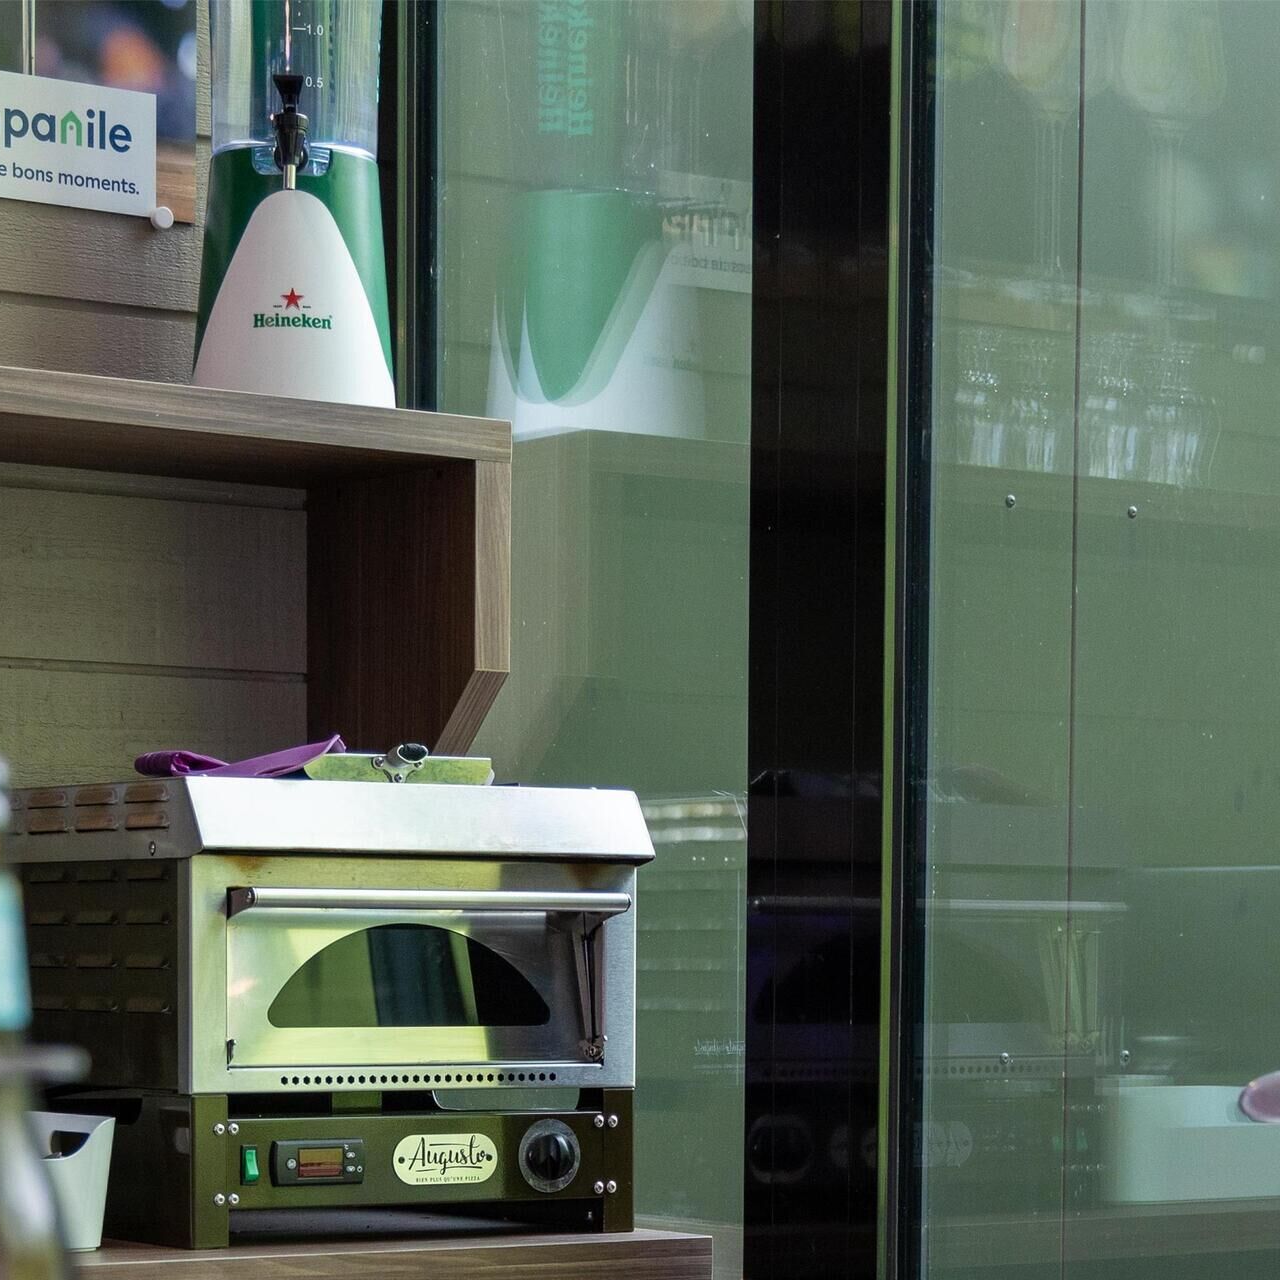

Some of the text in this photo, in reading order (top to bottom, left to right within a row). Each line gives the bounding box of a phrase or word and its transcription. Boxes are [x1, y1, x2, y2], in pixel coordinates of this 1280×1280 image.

[306, 24, 324, 36] 1.0
[305, 76, 324, 88] 0.5
[13, 163, 53, 183] bons
[58, 171, 140, 195] moments.
[252, 312, 332, 330] Heineken
[408, 1134, 486, 1175] Augusto
